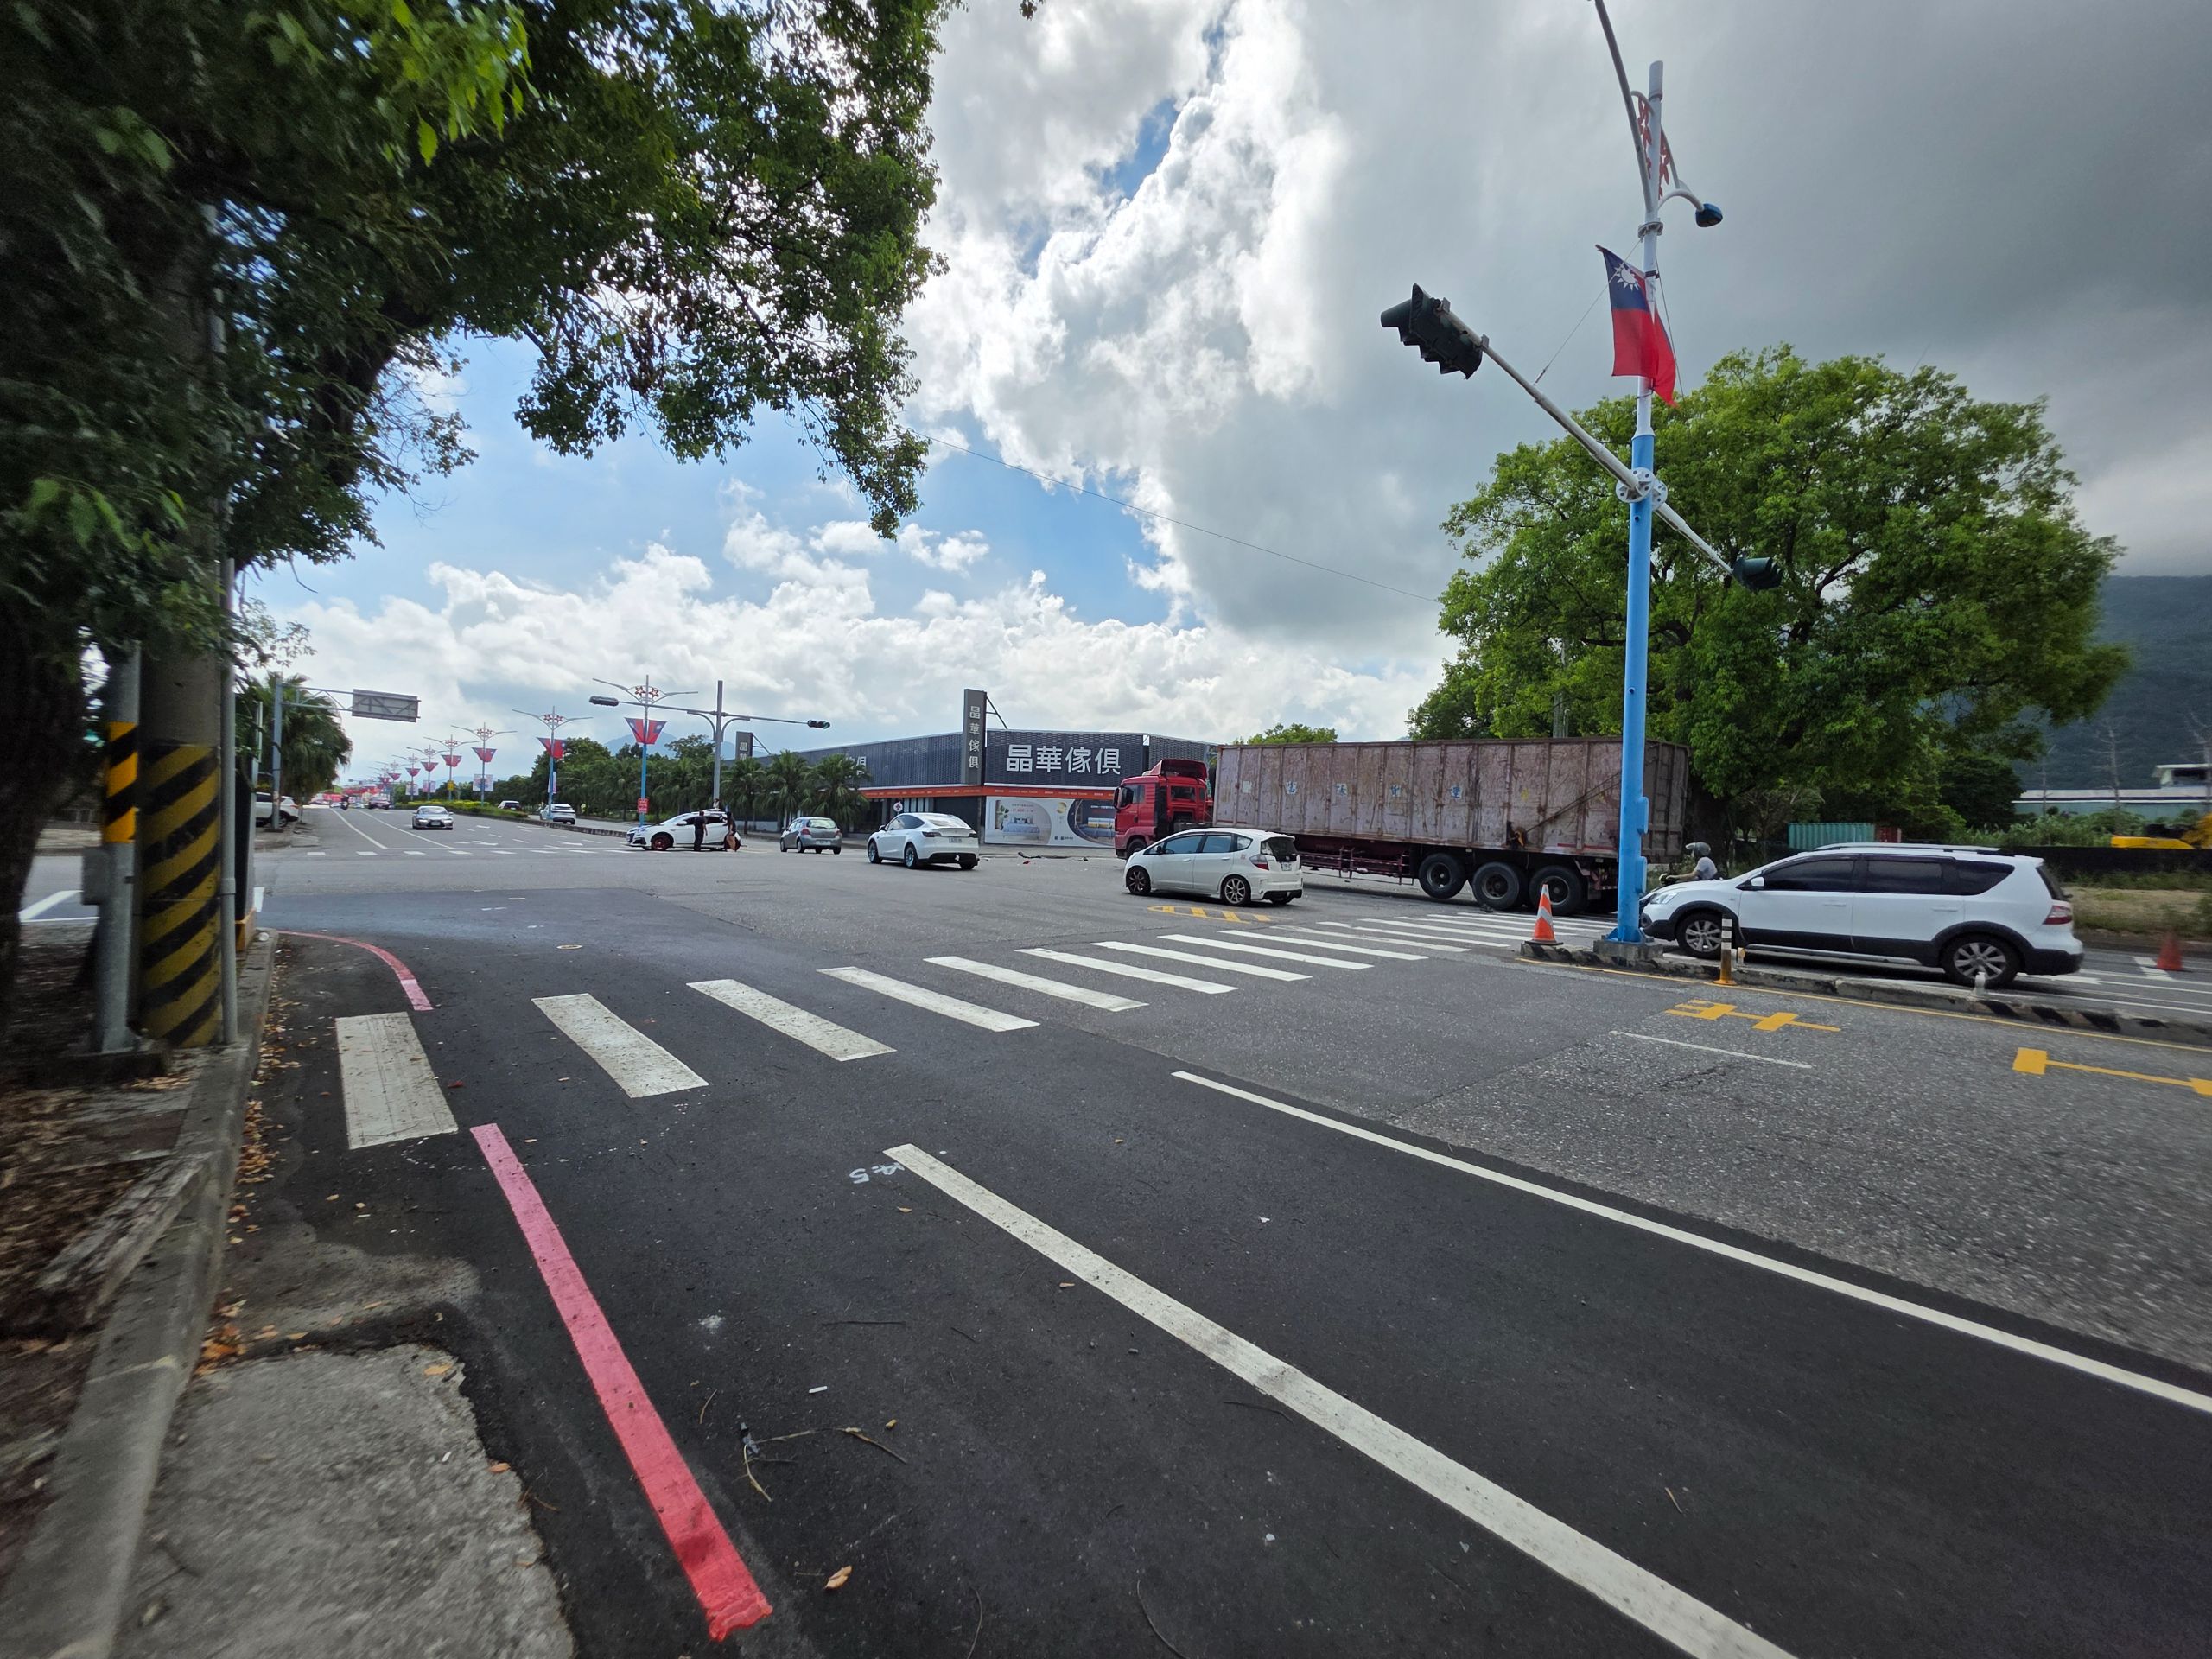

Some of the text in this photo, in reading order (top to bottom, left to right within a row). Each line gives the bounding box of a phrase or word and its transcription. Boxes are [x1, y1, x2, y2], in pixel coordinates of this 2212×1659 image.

[968, 705, 981, 769] 晶華傢俱
[1006, 744, 1122, 775] 晶華傢俱
